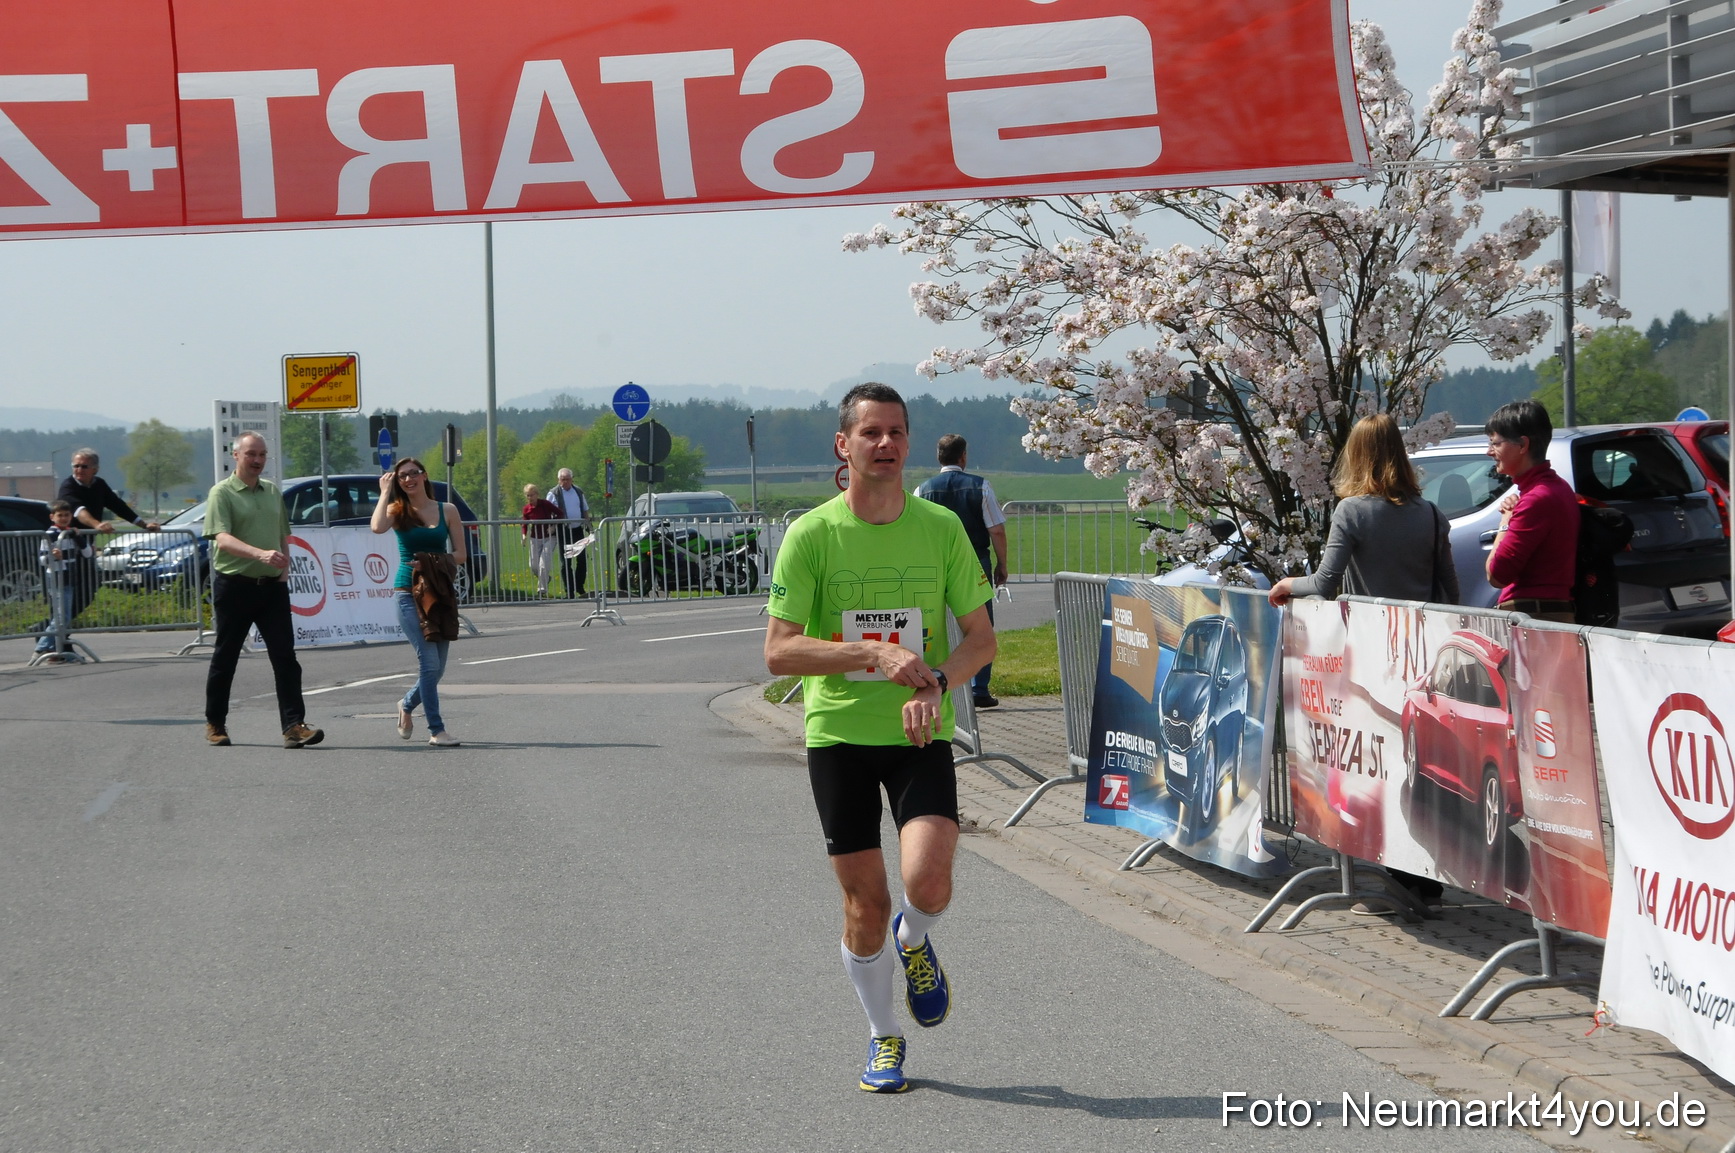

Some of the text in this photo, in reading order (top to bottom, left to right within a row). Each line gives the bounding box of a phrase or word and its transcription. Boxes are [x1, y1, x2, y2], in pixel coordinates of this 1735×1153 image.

[292, 363, 351, 381] Sengenthal
[317, 380, 343, 391] Anger
[289, 555, 315, 575] ART &
[367, 560, 386, 577] KIA
[333, 590, 361, 601] SEAT
[855, 613, 892, 622] MEYER
[1368, 732, 1388, 782] ST.
[1533, 765, 1569, 783] SEAT
[1665, 727, 1729, 808] KIA
[1103, 779, 1123, 805] 7
